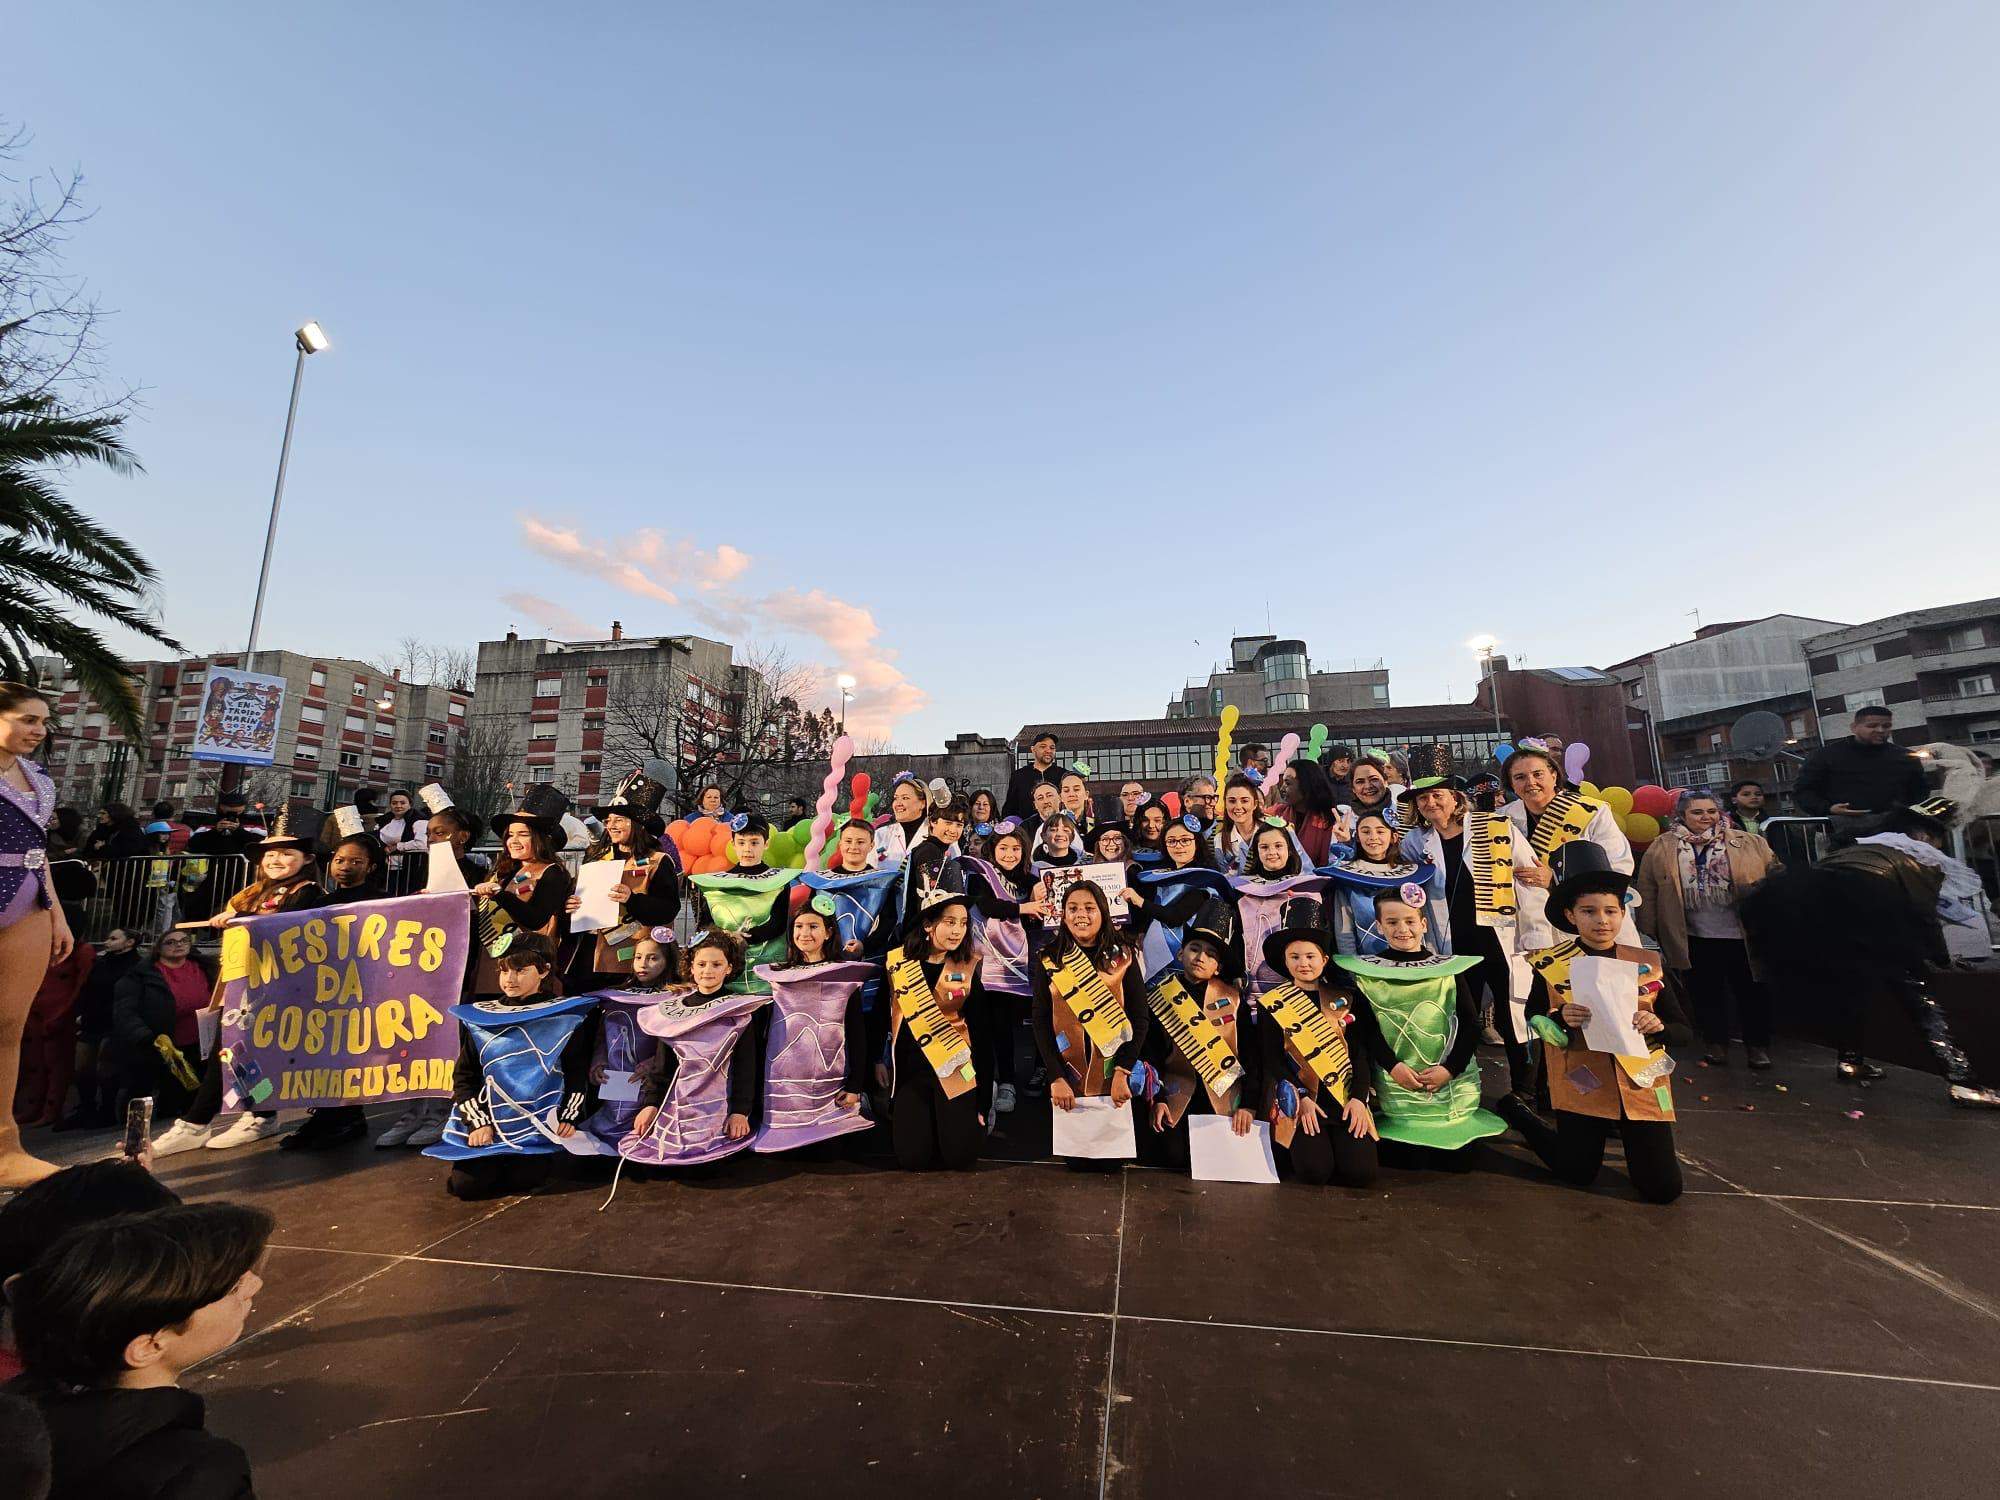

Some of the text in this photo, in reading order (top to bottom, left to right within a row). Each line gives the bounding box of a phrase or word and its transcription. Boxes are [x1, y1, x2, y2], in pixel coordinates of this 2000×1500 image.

[1493, 836, 1510, 844] 3
[1498, 906, 1516, 915] 0
[249, 913, 447, 989] MESTRES
[1535, 956, 1554, 969] 3
[315, 959, 363, 1005] DA
[253, 993, 444, 1056] COSTURA
[1063, 986, 1079, 1000] 1
[1078, 1008, 1095, 1024] 0
[918, 1034, 933, 1047] 0
[1172, 990, 1236, 1070] 0 1 2 3
[1267, 1000, 1339, 1087] 3 2 1 0
[279, 1058, 455, 1100] INMACULADA
